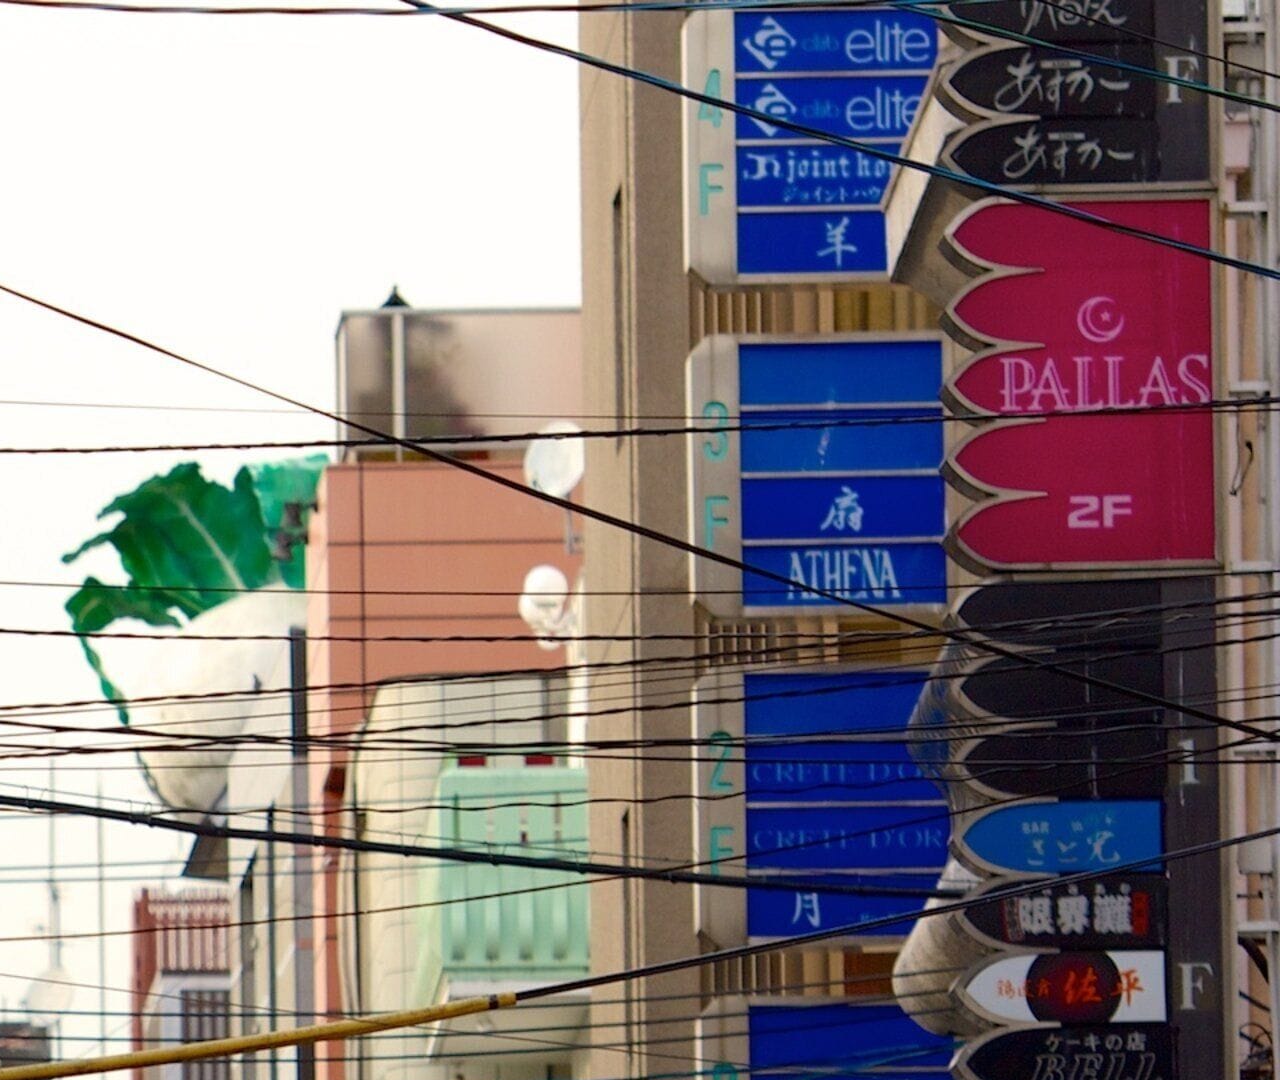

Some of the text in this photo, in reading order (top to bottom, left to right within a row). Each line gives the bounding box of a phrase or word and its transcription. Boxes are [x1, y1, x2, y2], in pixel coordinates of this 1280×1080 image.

[845, 19, 931, 64] elite
[787, 149, 850, 183] joint
[817, 217, 858, 268] 羊
[999, 353, 1212, 413] PALLAS
[1067, 495, 1133, 529] 2F
[787, 548, 902, 600] ATHENA
[1045, 1031, 1147, 1052] ケーキの店
